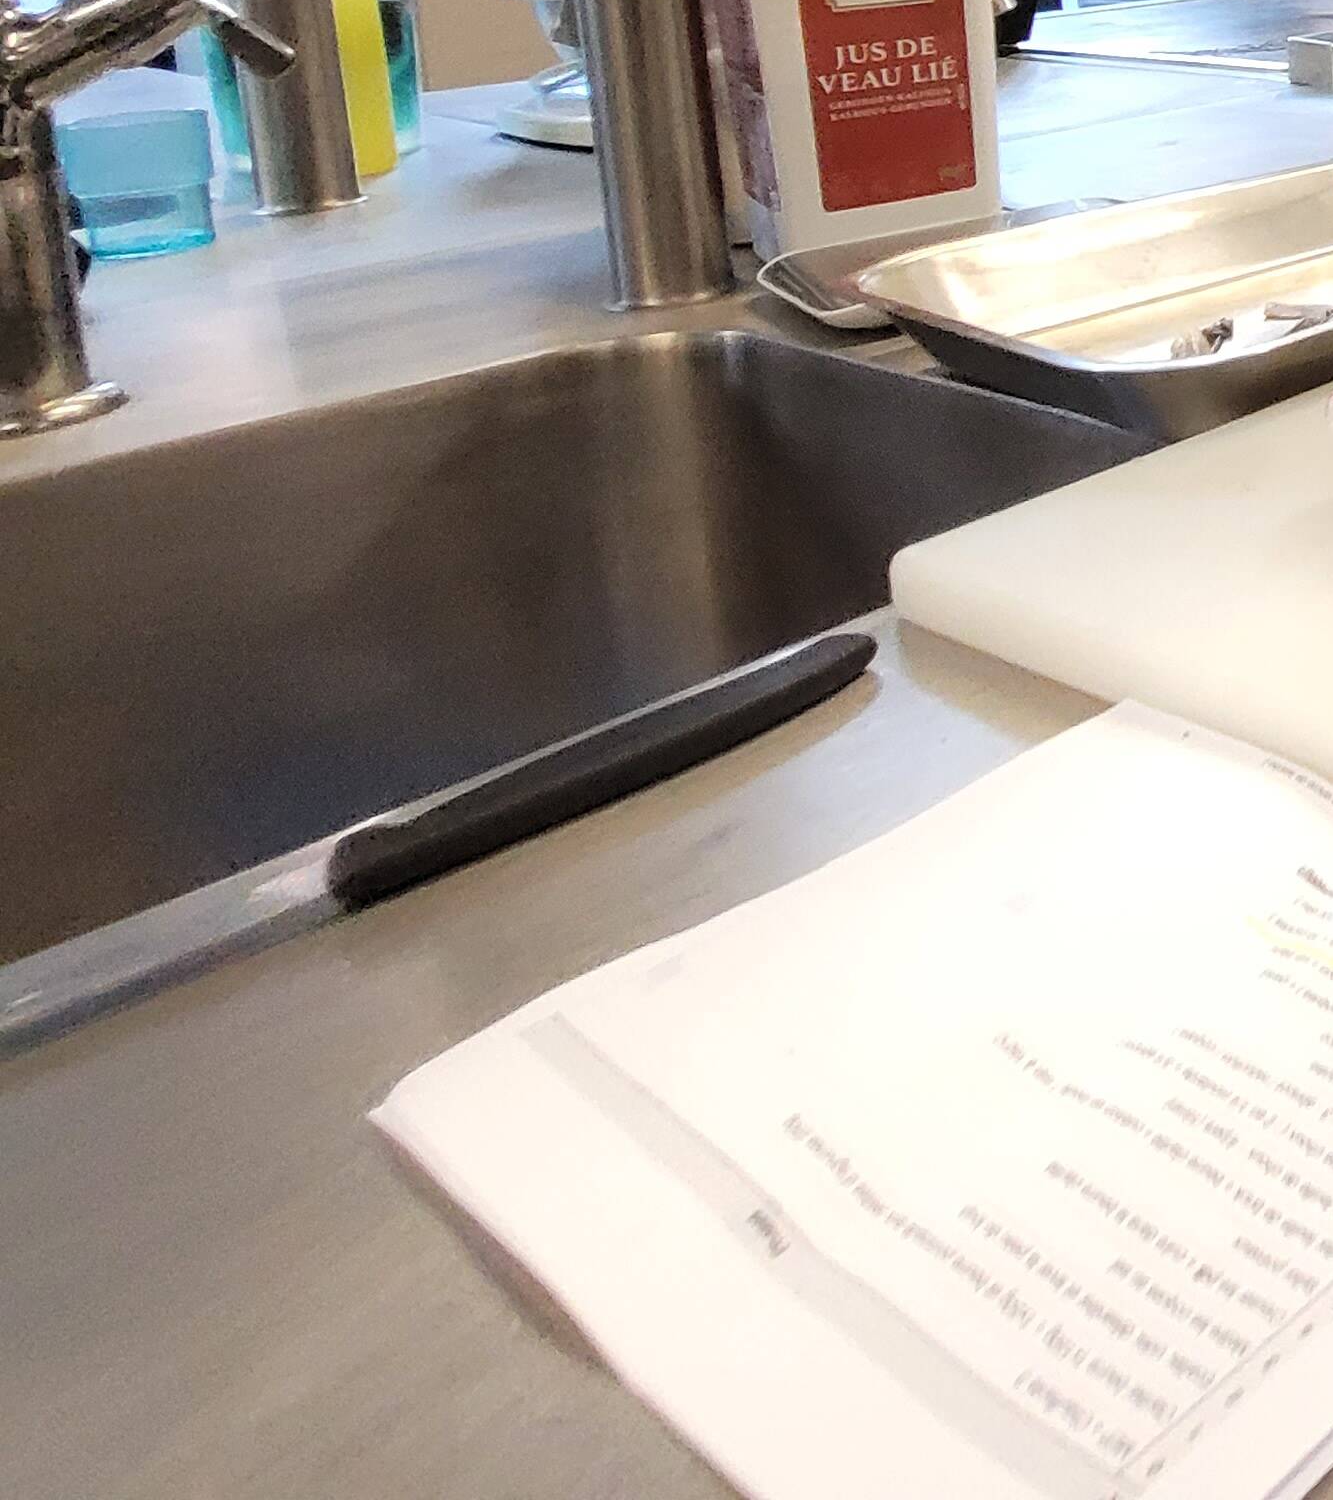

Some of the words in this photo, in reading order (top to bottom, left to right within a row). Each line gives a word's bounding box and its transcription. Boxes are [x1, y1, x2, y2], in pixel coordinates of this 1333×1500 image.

[835, 40, 888, 70] JUS
[896, 36, 937, 58] DE
[817, 66, 902, 95] VEAU
[911, 55, 958, 83] LIÉ
